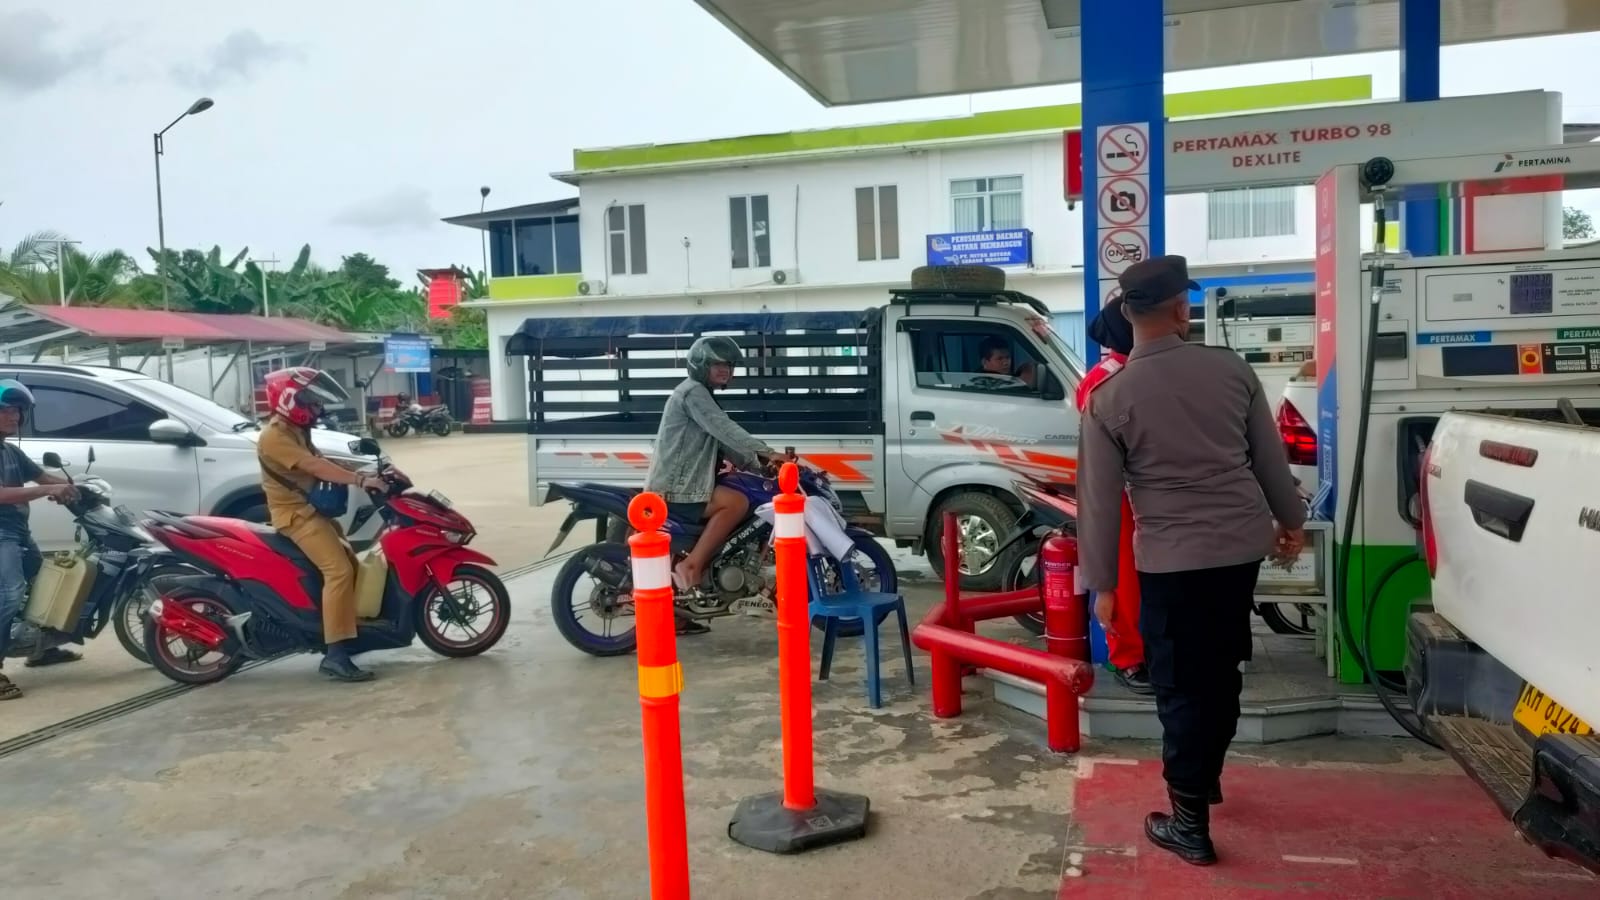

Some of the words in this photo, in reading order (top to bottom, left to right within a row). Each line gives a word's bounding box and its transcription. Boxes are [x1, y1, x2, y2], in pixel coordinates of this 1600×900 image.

[1173, 132, 1278, 153] PERTAMAX
[1290, 125, 1361, 143] TURBO
[1366, 123, 1392, 137] 98
[1232, 151, 1302, 168] DEXLITE
[1518, 156, 1572, 168] PERTAMINA
[1107, 249, 1123, 257] ON
[1430, 334, 1476, 343] PERTAMAX
